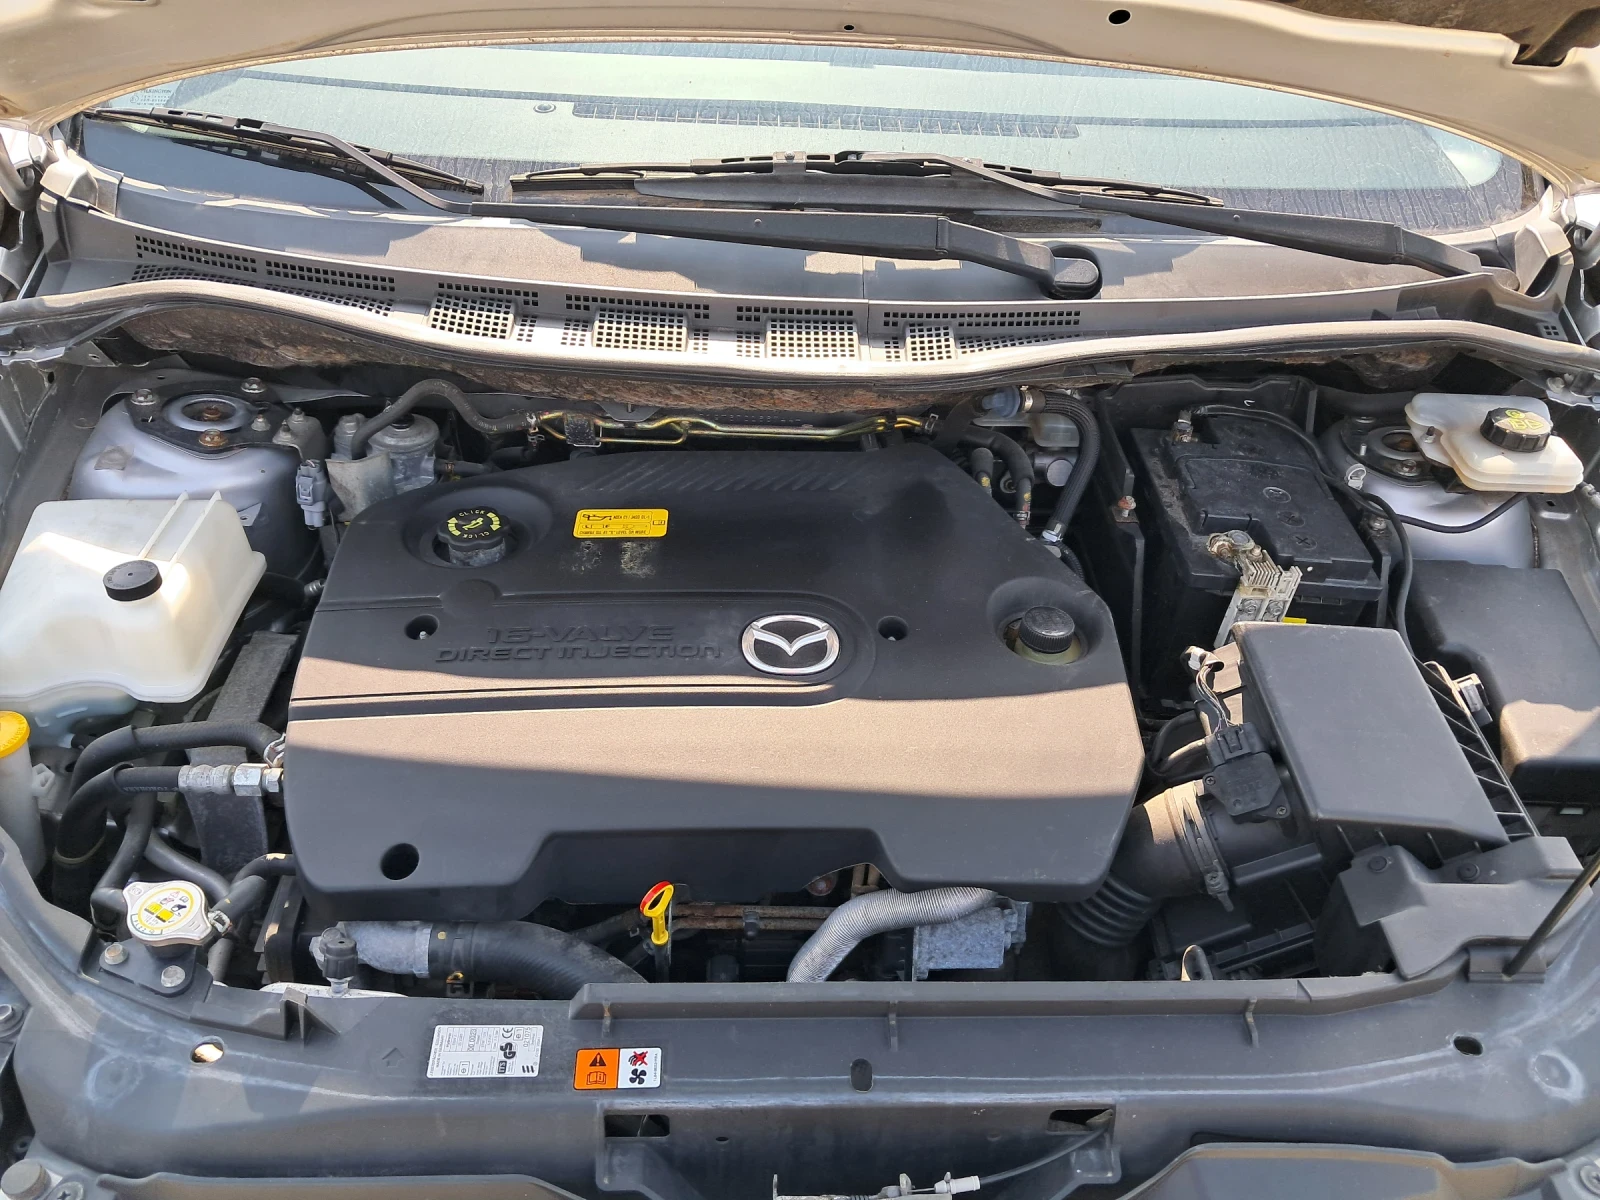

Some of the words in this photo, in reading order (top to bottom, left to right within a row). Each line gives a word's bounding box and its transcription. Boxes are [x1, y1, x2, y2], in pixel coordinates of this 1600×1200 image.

[487, 625, 676, 643] 16-VALVE
[434, 646, 552, 662] DIRECT
[558, 642, 721, 660] INJECTION
[502, 1027, 513, 1038] CE
[500, 1042, 516, 1059] GS
